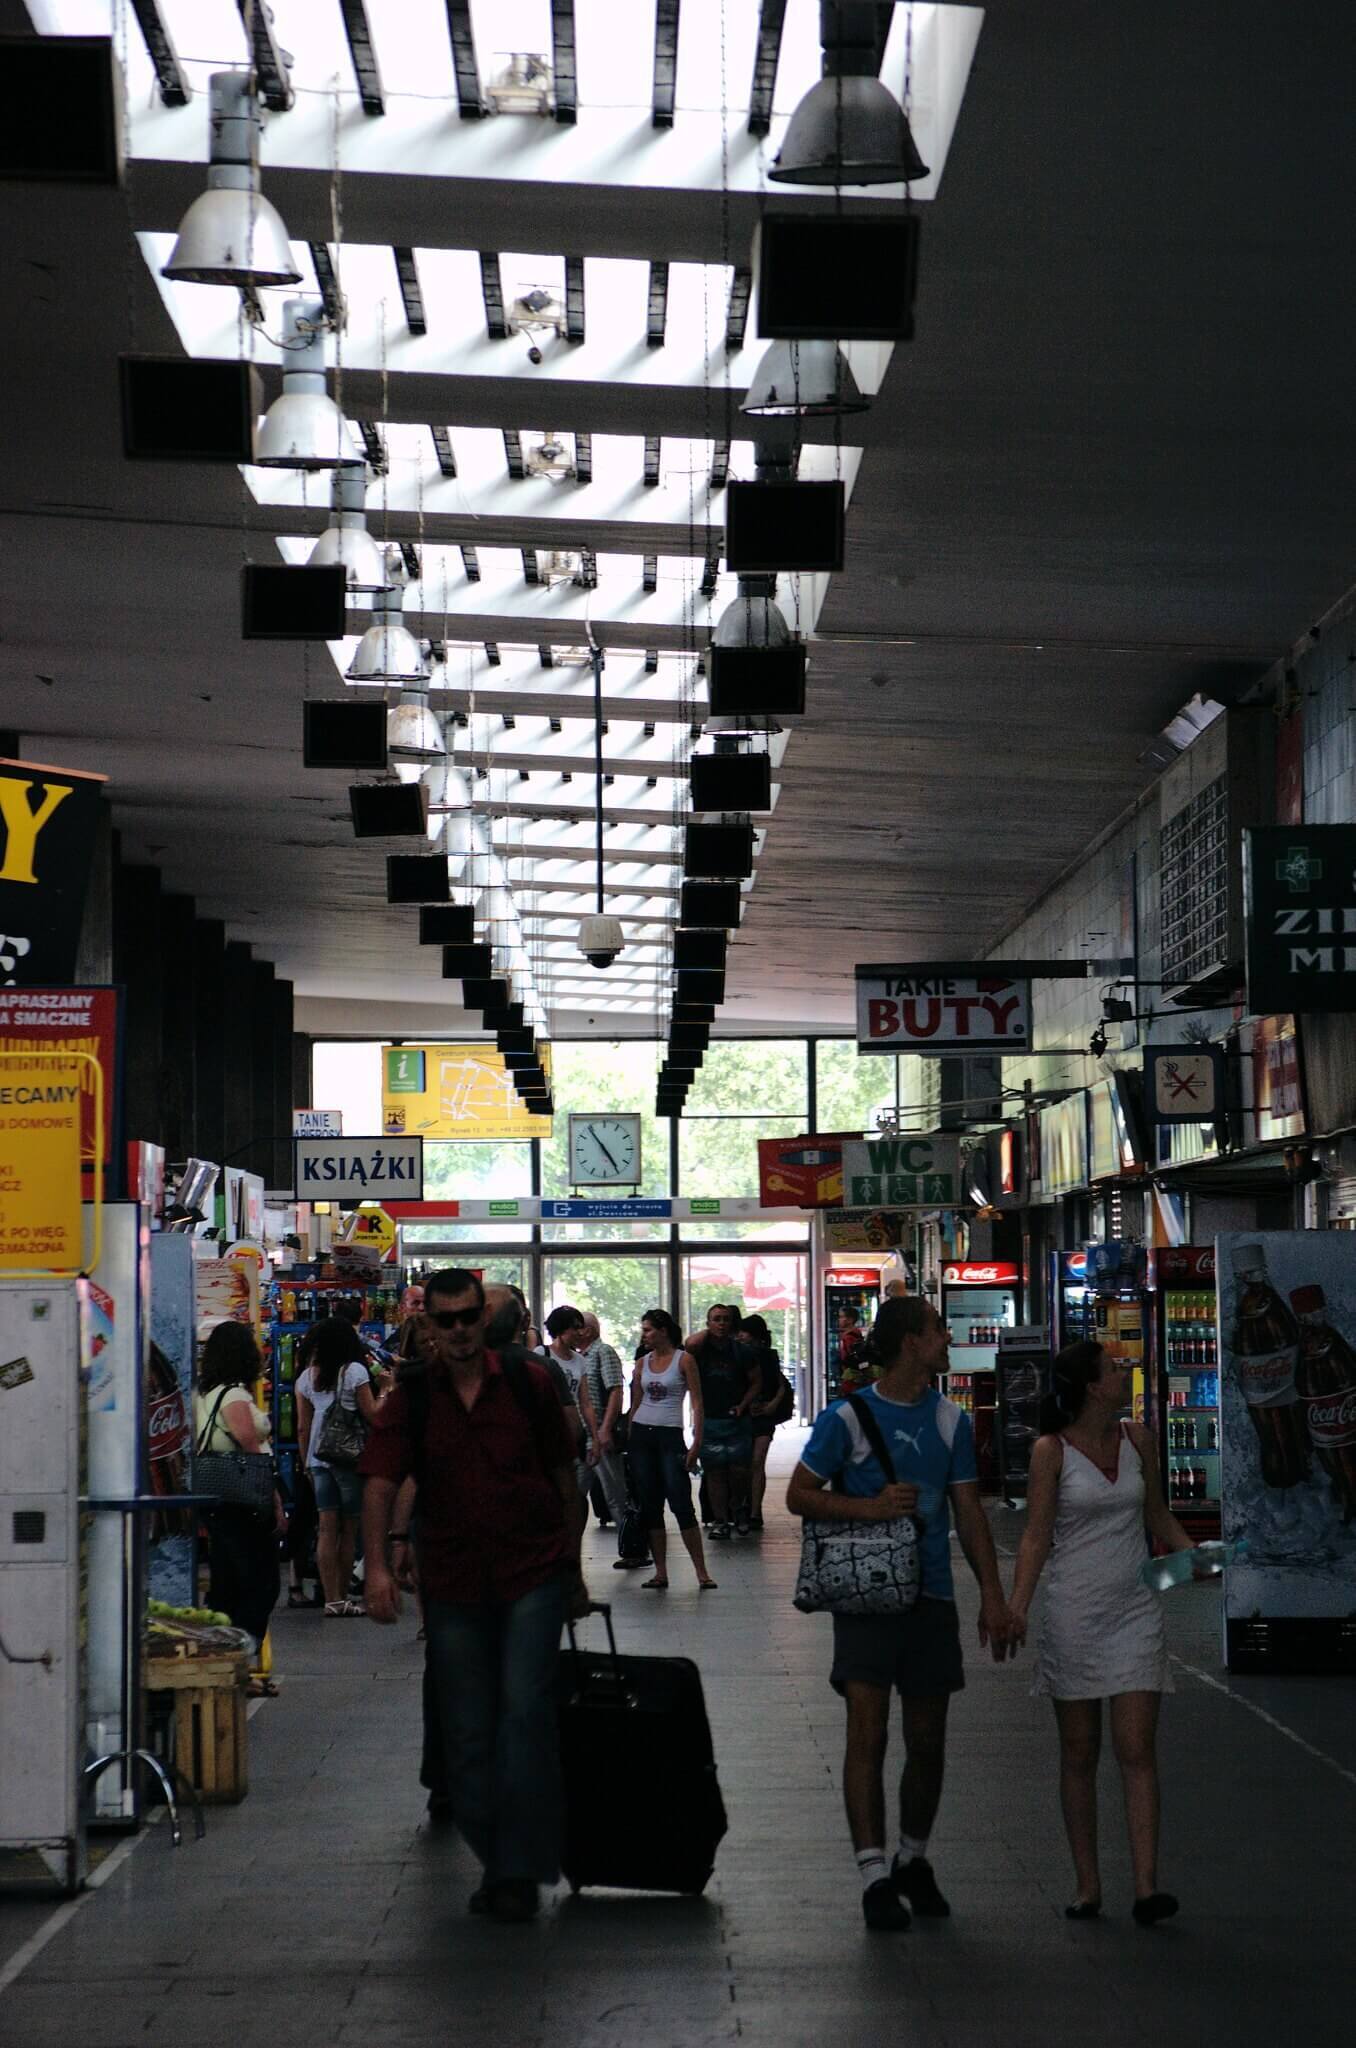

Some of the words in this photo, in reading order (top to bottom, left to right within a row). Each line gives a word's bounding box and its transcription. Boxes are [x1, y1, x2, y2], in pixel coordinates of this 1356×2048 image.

[882, 976, 955, 996] TAKIE
[14, 1012, 91, 1026] SMACZNE
[868, 996, 1020, 1037] BUTY
[297, 1113, 330, 1127] TANIE
[303, 1150, 416, 1187] KSIĄŻKI
[866, 1139, 933, 1175] WC
